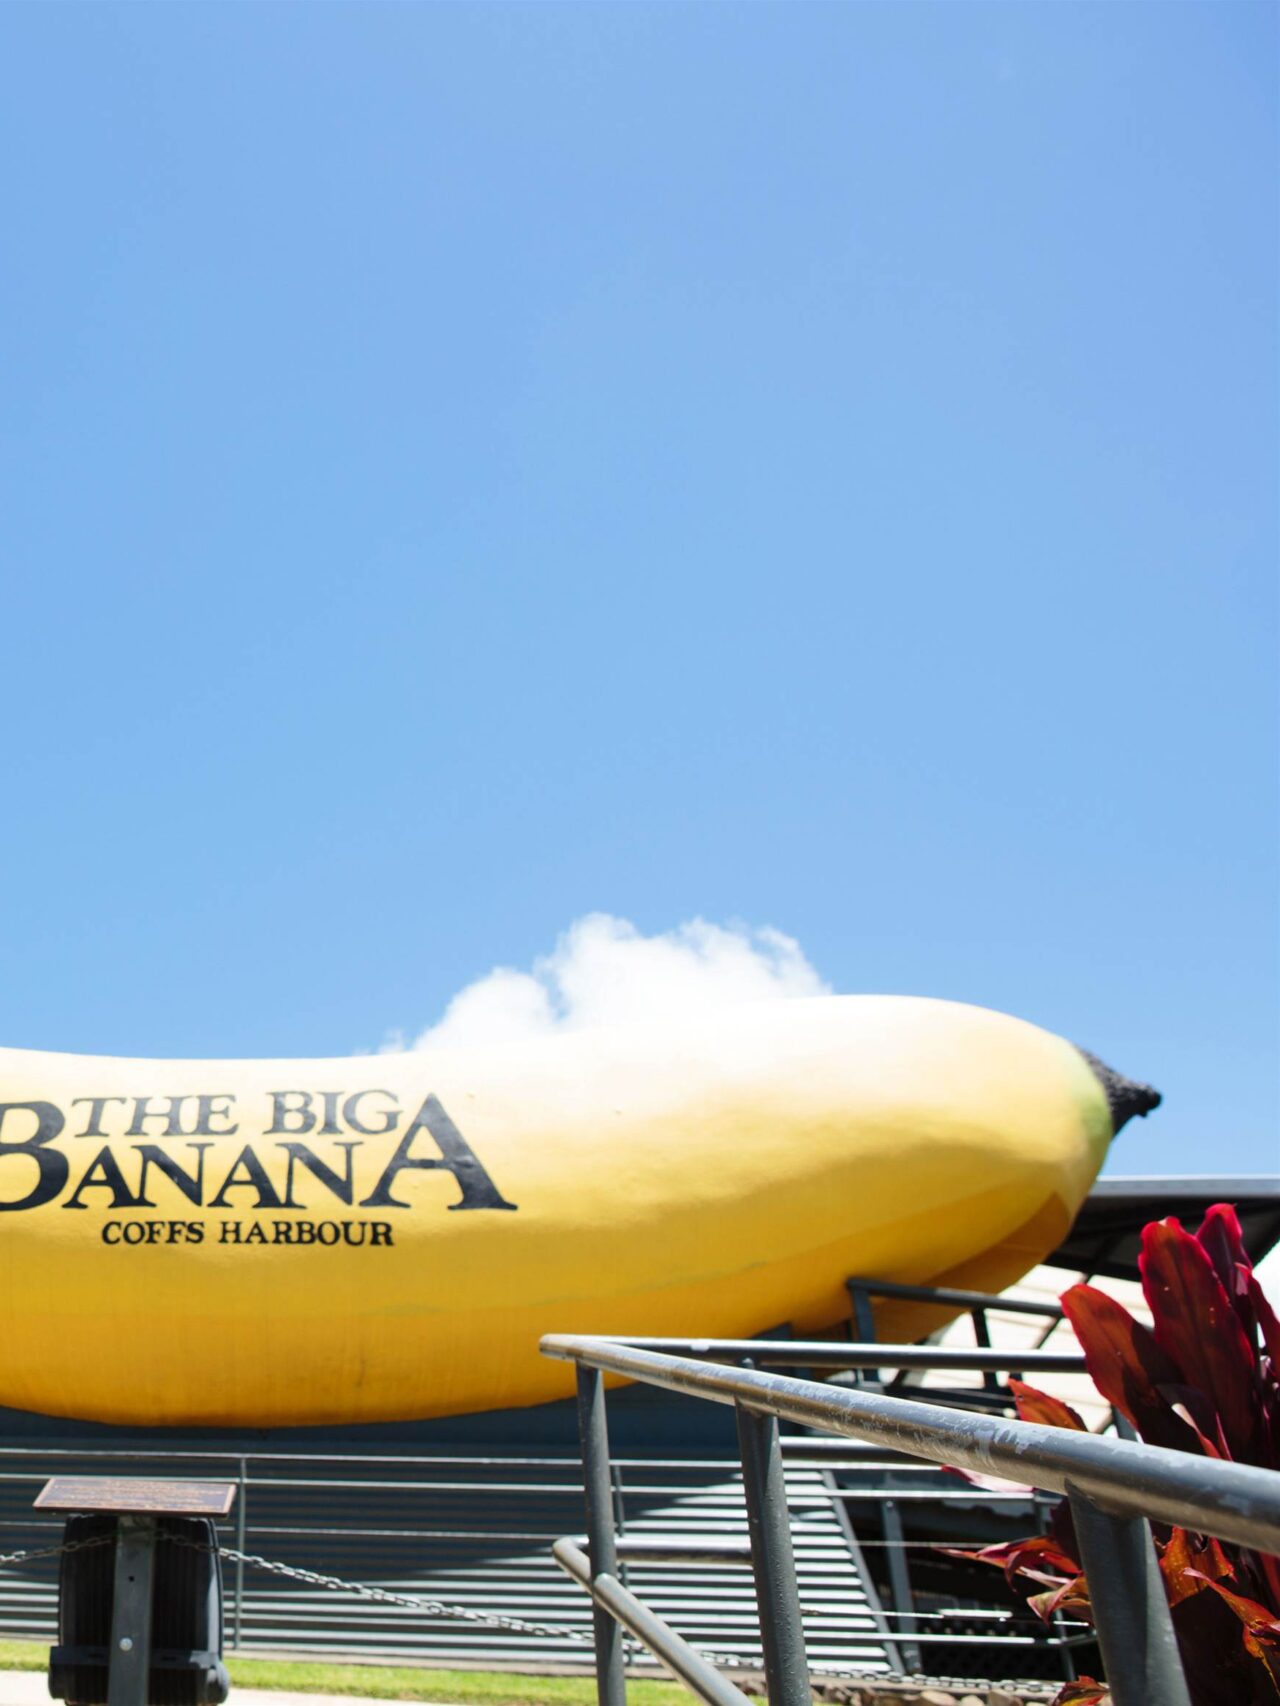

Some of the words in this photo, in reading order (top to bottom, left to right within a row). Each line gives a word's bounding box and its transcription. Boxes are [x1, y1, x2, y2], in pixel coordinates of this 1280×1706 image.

[71, 1094, 240, 1138] THE
[262, 1088, 404, 1135] BIG
[101, 1221, 205, 1245] COFFS
[218, 1221, 396, 1246] HARBOUR
